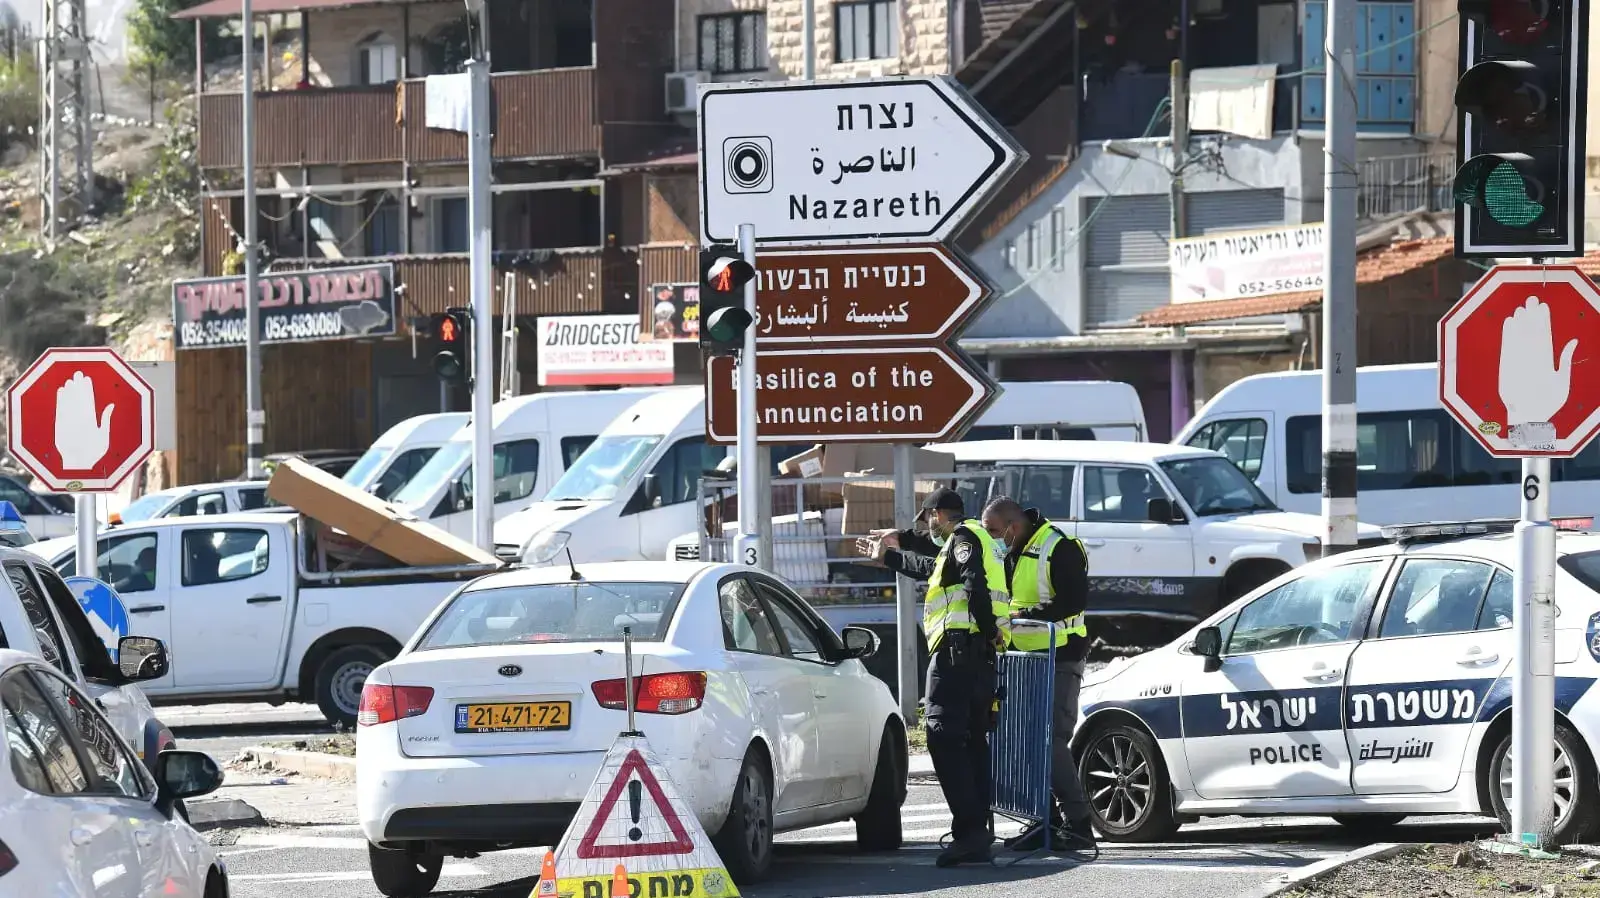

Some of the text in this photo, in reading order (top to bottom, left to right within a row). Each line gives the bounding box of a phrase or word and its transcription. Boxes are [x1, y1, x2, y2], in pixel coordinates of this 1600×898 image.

[837, 102, 914, 131] נצרת
[811, 146, 916, 185] الناصرة
[789, 190, 941, 220] Nazareth
[1175, 241, 1217, 268] העוקף
[755, 265, 926, 291] כנסיית הבשור
[1239, 276, 1323, 294] 052-56646
[259, 277, 304, 308] רכב
[846, 301, 909, 329] كنيسة
[181, 319, 248, 345] 052-354008
[545, 321, 641, 346] BRIDGESTO
[851, 366, 877, 388] of
[891, 366, 933, 388] the
[1523, 474, 1540, 501] 6
[745, 547, 757, 566] 3
[1220, 689, 1475, 729] משטרת ישראל
[1250, 743, 1323, 765] POLICE
[1359, 737, 1434, 764] الشرطة
